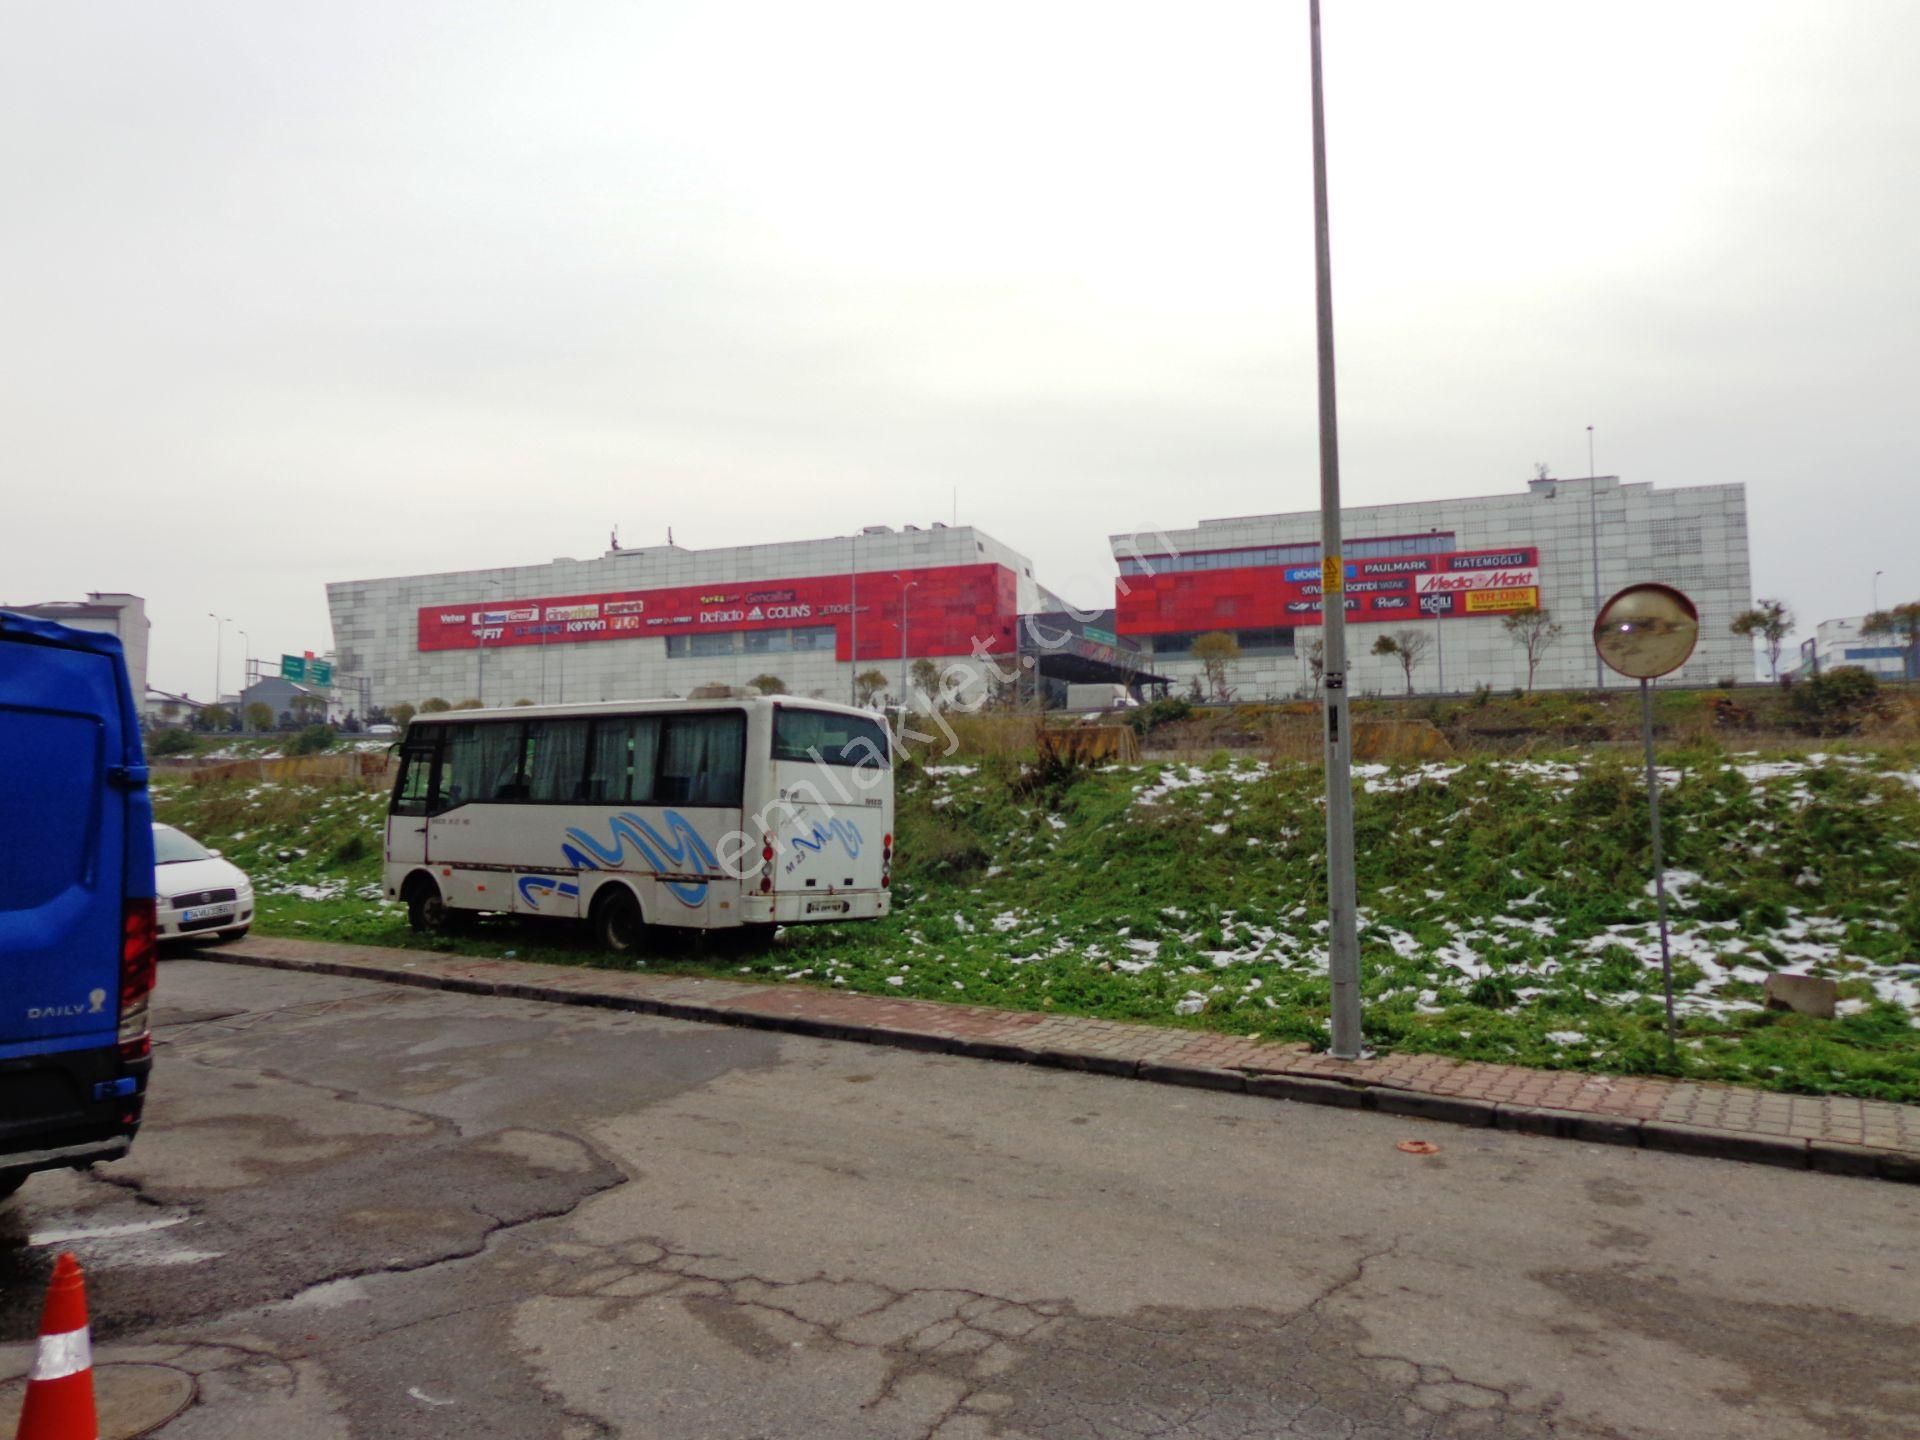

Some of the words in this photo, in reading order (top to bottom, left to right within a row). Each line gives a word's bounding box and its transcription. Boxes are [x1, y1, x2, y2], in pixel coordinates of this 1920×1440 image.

[1365, 561, 1427, 573] PAULMARK
[1346, 581, 1377, 592] bambi
[1422, 575, 1473, 591] Media
[1485, 571, 1533, 587] Markt
[700, 610, 744, 624] DeFacto
[767, 604, 811, 619] COLIN'S
[27, 1004, 84, 1018] DAILY
